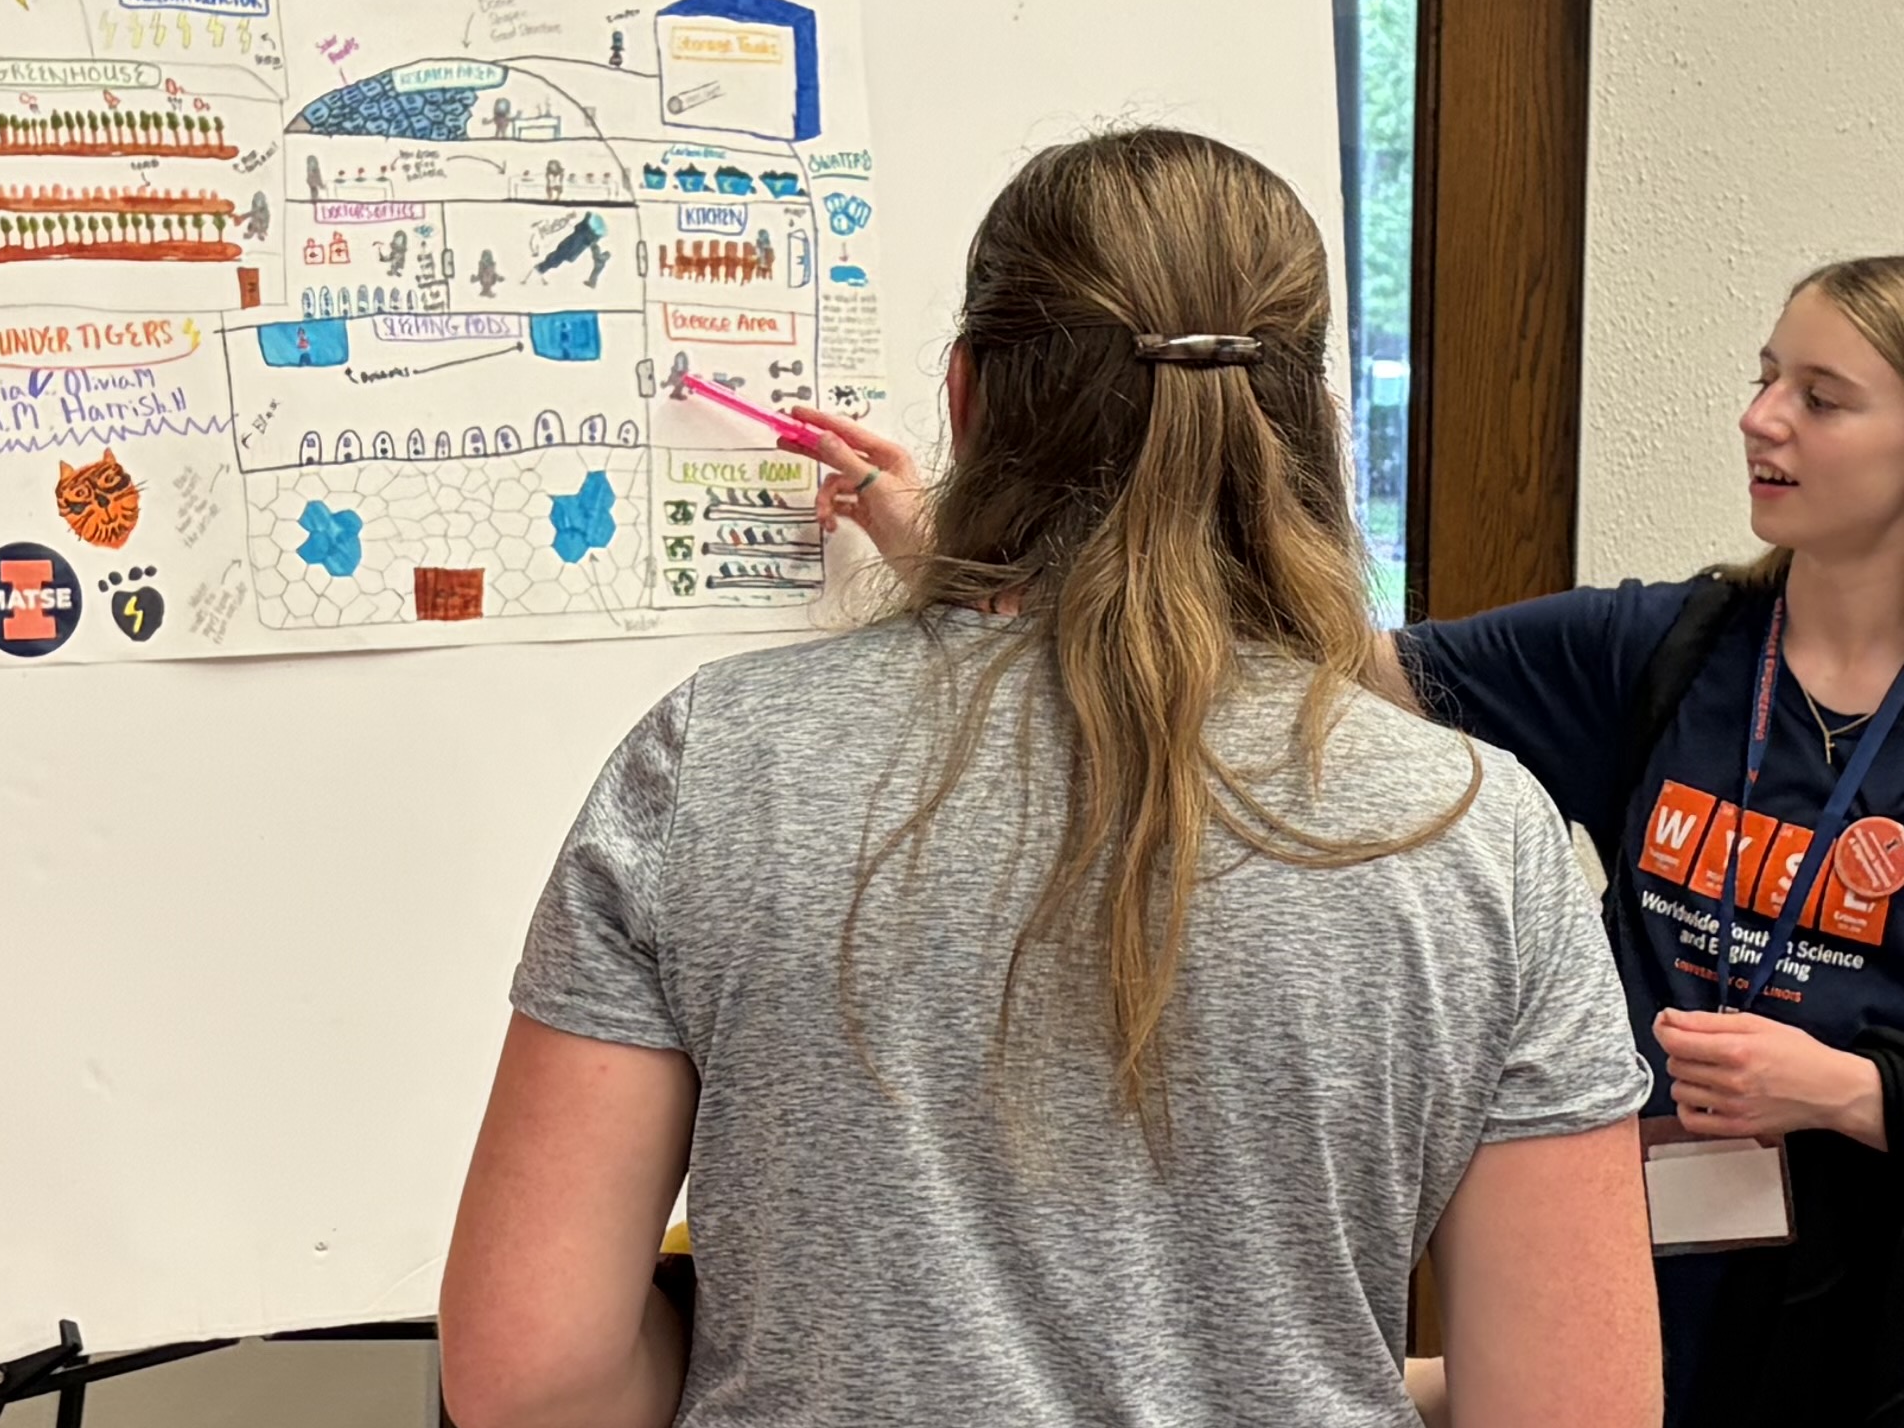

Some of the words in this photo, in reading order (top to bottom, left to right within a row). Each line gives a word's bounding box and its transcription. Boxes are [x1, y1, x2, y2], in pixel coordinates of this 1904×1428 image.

[686, 208, 745, 228] KITCHEN
[737, 314, 778, 332] Area
[76, 320, 174, 350] TIGERS
[682, 462, 747, 483] RECYCLE
[759, 460, 801, 481] ROOM
[1642, 890, 1720, 934] Worldwide
[1730, 922, 1771, 947] out
[1796, 940, 1864, 969] Science
[1679, 928, 1707, 951] and
